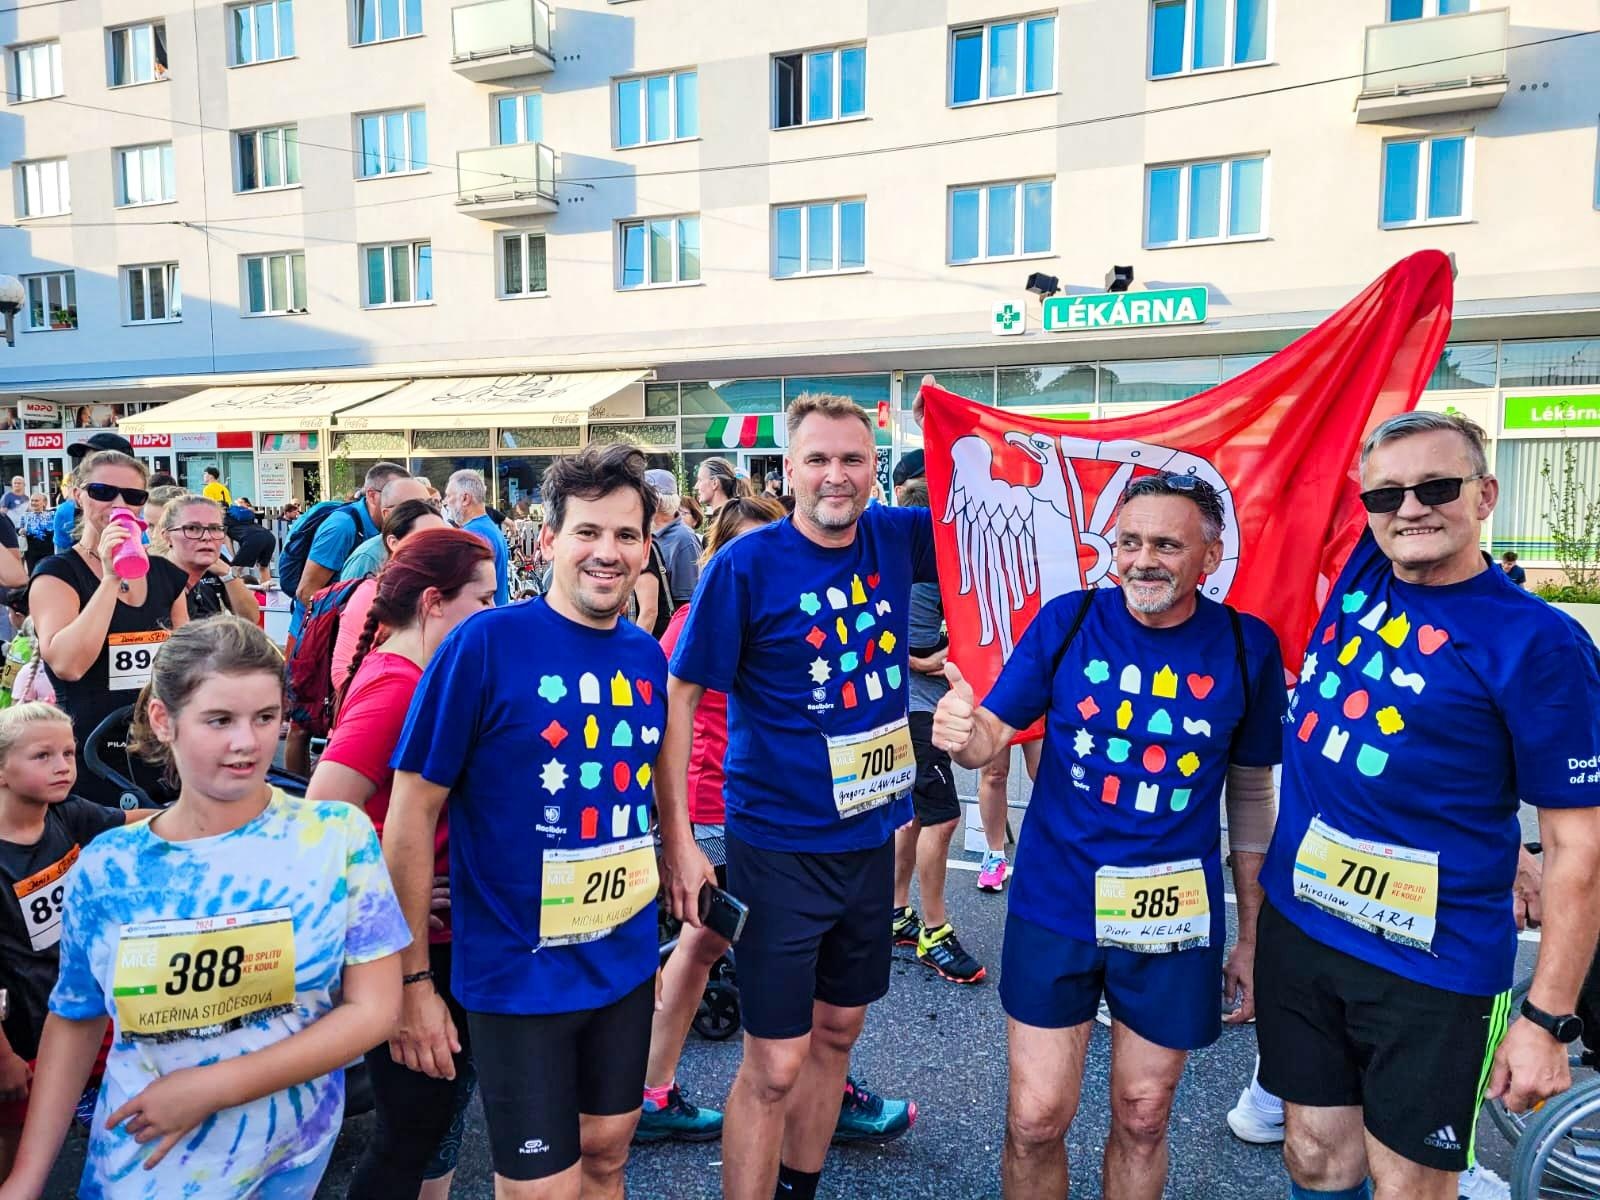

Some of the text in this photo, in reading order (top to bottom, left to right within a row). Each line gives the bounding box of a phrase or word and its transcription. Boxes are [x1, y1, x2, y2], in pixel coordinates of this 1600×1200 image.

[1050, 294, 1198, 329] LÉKÁRNA
[26, 403, 54, 412] MDPO
[1531, 404, 1600, 422] Lékárn
[28, 435, 61, 448] MDPO
[132, 434, 168, 446] MDPO
[115, 649, 156, 671] 89
[861, 744, 894, 780] 700
[1569, 772, 1586, 784] od
[582, 866, 627, 904] 216
[1337, 859, 1390, 900] 701
[1131, 886, 1179, 919] 385
[1358, 902, 1415, 931] LARA
[1104, 922, 1192, 936] Piotr KIELAR
[255, 949, 282, 962] SPLITU
[165, 945, 245, 996] 388
[139, 1006, 199, 1026] KATEŘINA
[1423, 1137, 1462, 1150] adidas
